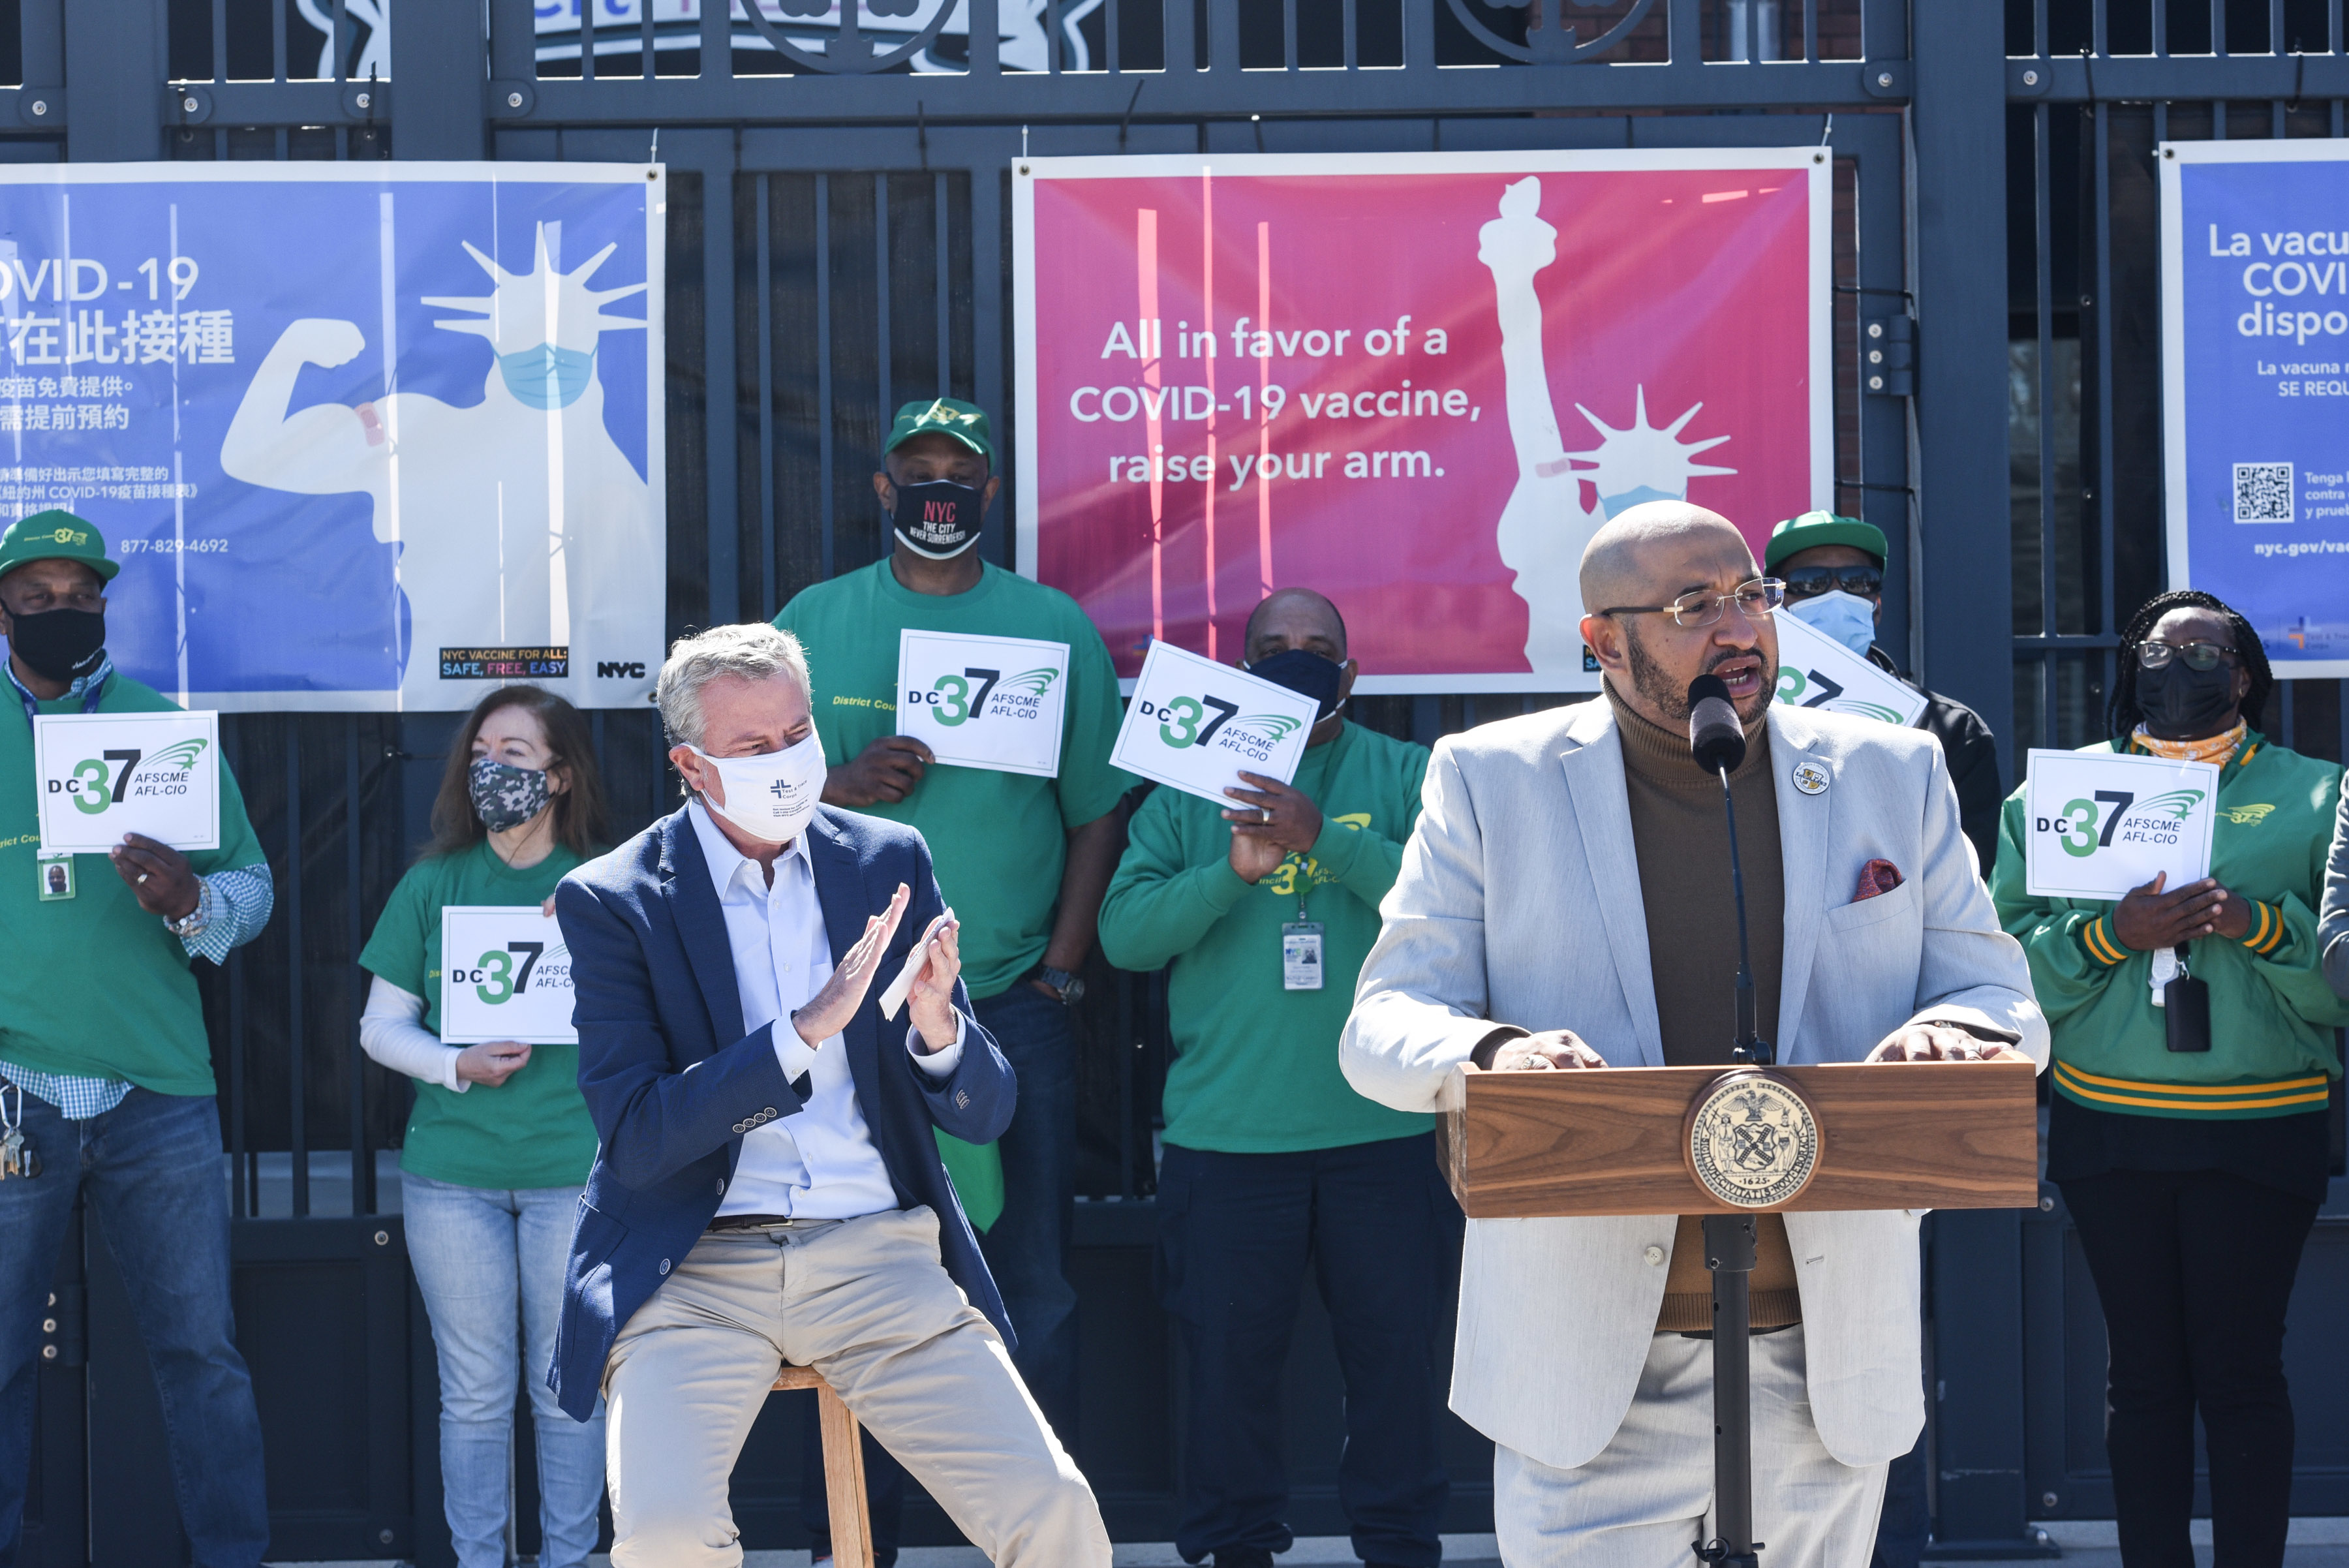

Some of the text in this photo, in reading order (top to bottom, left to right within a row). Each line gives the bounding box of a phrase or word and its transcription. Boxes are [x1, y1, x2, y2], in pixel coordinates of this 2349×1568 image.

[2209, 223, 2349, 257] La vacu
[2243, 261, 2347, 297] COVI
[2237, 301, 2348, 346] dispo
[0, 309, 235, 366] 在此接種
[1100, 315, 1448, 360] All in favor of a
[2257, 360, 2277, 375] La
[2280, 362, 2341, 375] vacuna
[2278, 380, 2300, 397] SE
[1069, 379, 1481, 422] COVID-19 vaccine,
[0, 403, 129, 431] 需提前預約
[1109, 444, 1445, 492] raise your arm.
[2304, 471, 2344, 487] Tenga
[0, 484, 46, 500] 紐約州
[2305, 489, 2346, 500] contra
[924, 500, 956, 523] NYC
[2305, 507, 2313, 520] y
[909, 525, 927, 541] NEVER
[923, 521, 957, 534] THE CITY
[121, 538, 228, 554] 877-829-4692
[442, 649, 567, 660] NYC VACCINE FOR ALL:
[442, 661, 566, 677] SAFE, FREE, EASY
[597, 661, 645, 679] NYC
[1586, 657, 1601, 669] SA
[833, 696, 897, 711] District Cou
[990, 693, 1041, 708] AFSCME
[990, 705, 1037, 720] AFL-CIO
[1222, 726, 1276, 752] AFSCME
[1219, 738, 1268, 762] AFL-CIO
[134, 771, 189, 783] AFSCME
[134, 785, 187, 796] AFL-CIO
[2123, 817, 2182, 833] AFSCME
[2122, 831, 2178, 846] AFL-CIO
[536, 965, 570, 975] AFSC
[536, 977, 574, 987] AFL-CI
